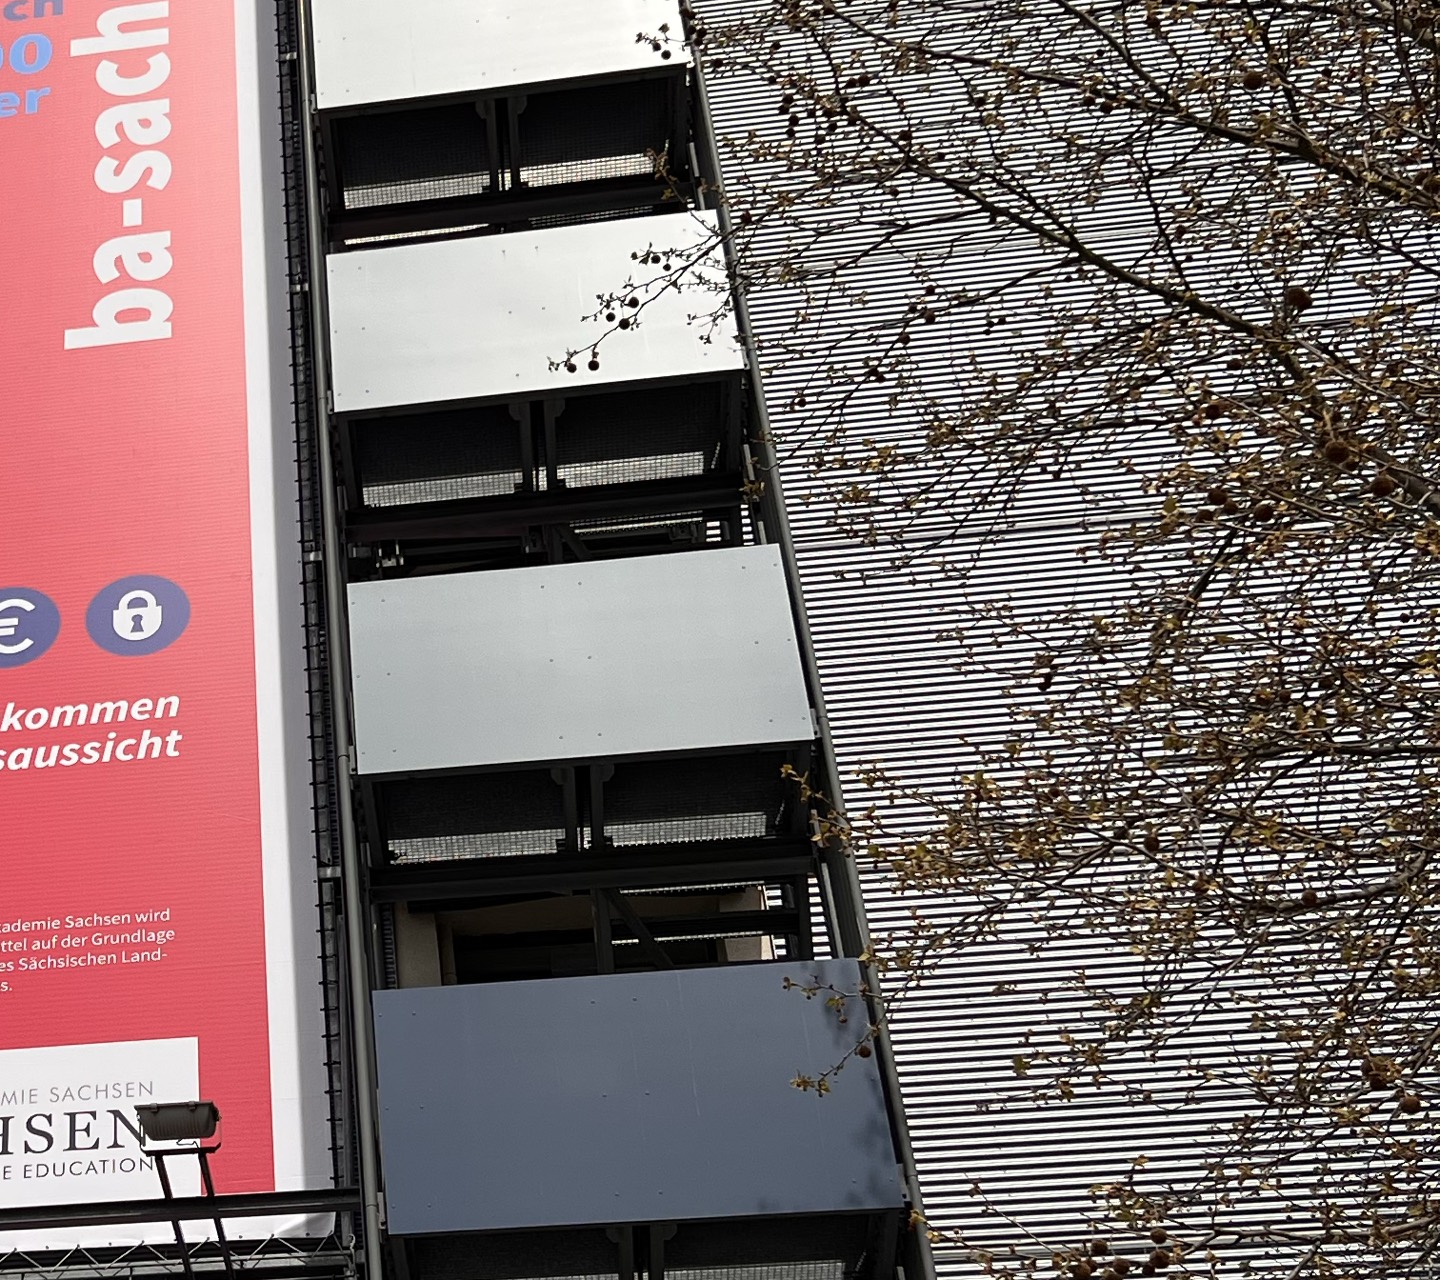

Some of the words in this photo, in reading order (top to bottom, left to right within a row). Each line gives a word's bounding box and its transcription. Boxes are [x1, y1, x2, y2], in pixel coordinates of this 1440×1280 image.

[64, 911, 131, 928] Sachsen
[134, 908, 171, 923] wird
[31, 935, 58, 951] auf
[60, 932, 88, 949] der
[91, 927, 176, 947] Grundlage
[17, 950, 117, 972] Sächsischen
[121, 946, 169, 965] Land-
[49, 1080, 155, 1103] SACHSEN
[22, 1155, 156, 1181] EDUCATION
